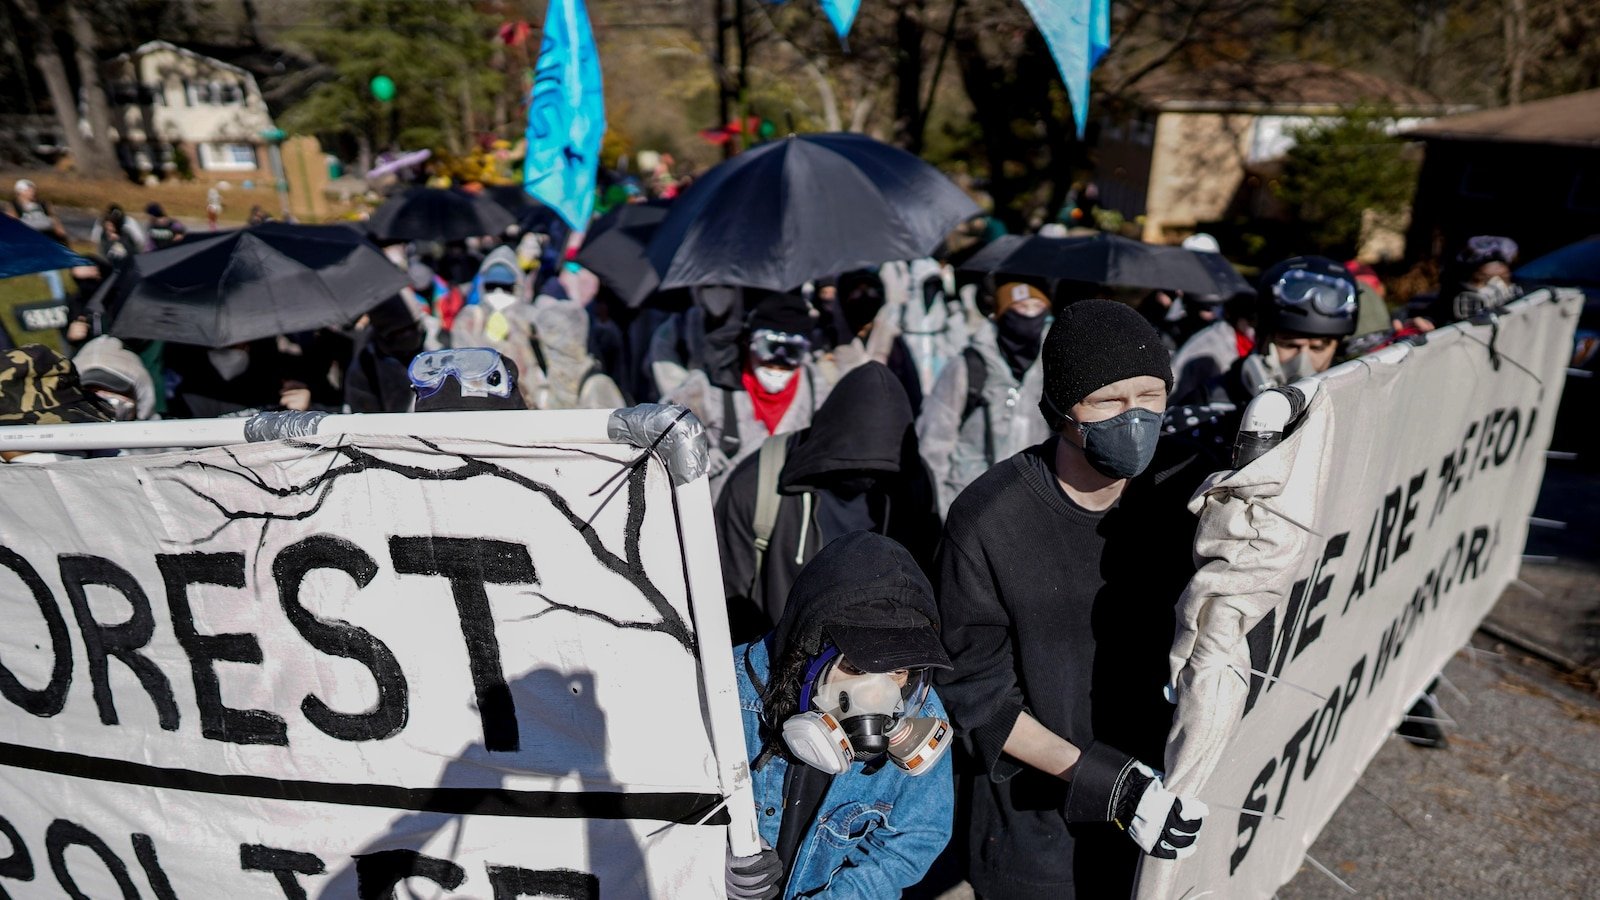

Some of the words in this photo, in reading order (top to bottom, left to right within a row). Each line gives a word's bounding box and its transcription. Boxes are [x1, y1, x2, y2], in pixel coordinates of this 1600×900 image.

[1241, 531, 1349, 719] WE
[1341, 468, 1428, 616] ARE
[1229, 654, 1367, 876] STOP
